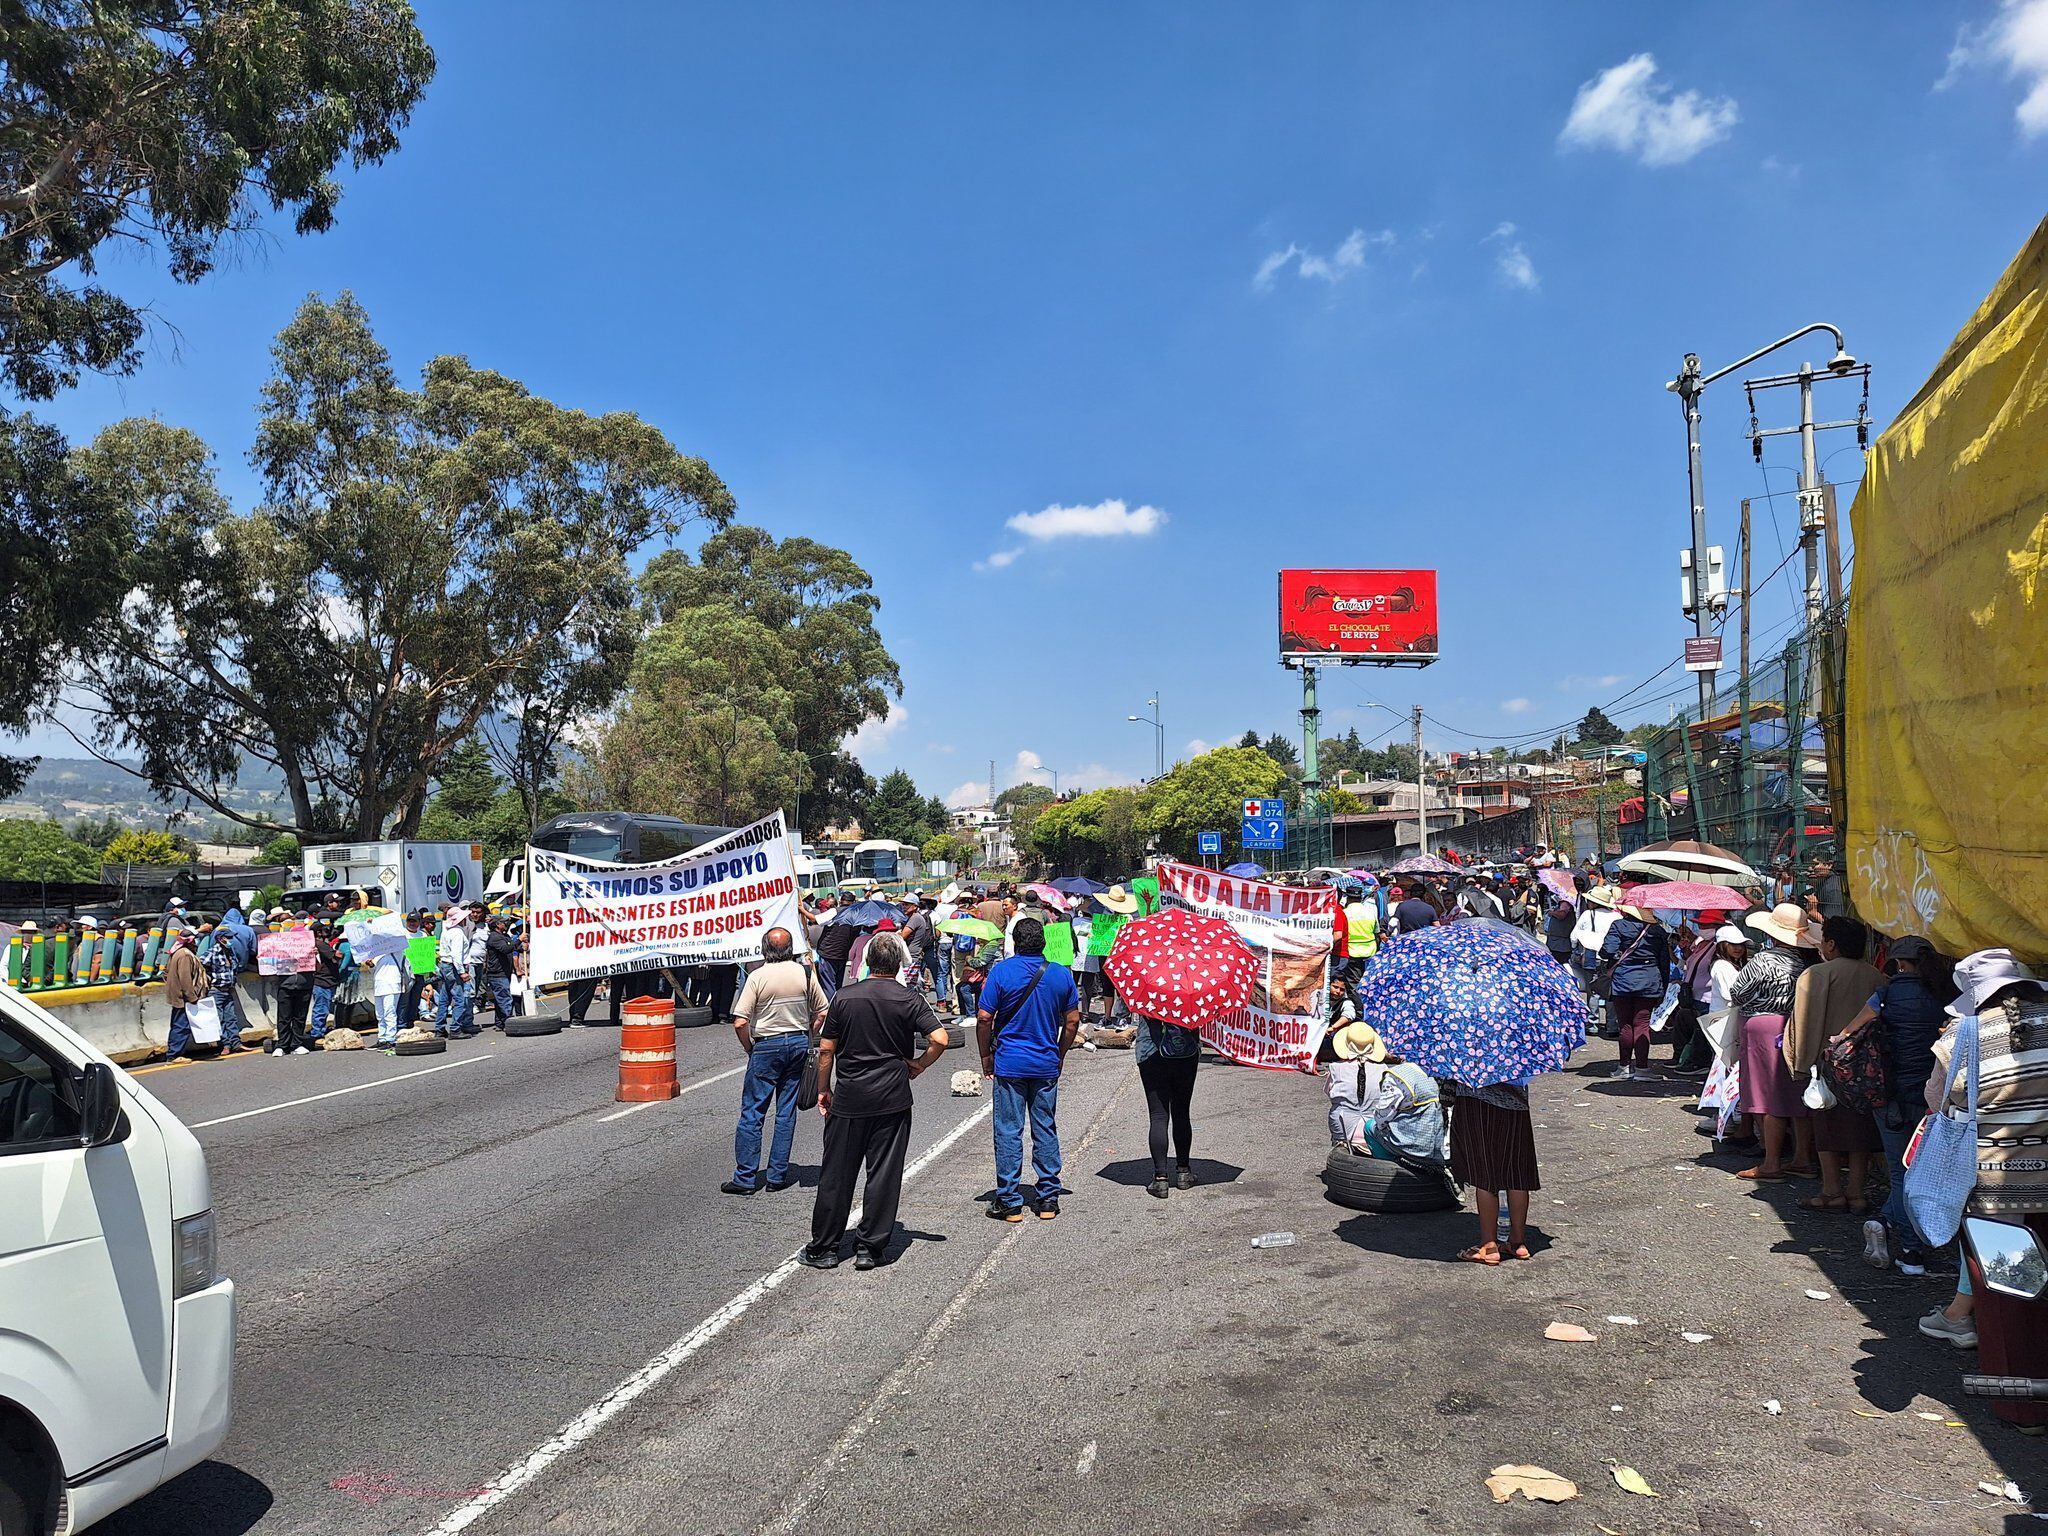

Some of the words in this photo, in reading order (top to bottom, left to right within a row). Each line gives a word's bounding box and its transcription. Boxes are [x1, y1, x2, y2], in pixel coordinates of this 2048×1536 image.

[1265, 809, 1281, 817] 074
[535, 854, 560, 873] SR.
[558, 874, 663, 899] PEDIMOS
[669, 867, 698, 891] SU
[703, 851, 768, 885] APOYO
[427, 871, 443, 887] red
[1159, 867, 1211, 903] ALTO
[1217, 878, 1233, 906] A
[1240, 883, 1271, 912] LA
[1279, 889, 1336, 914] TALA
[535, 909, 563, 928] LOS
[567, 902, 665, 925] TALAMONTES
[669, 893, 715, 916] ESTÁN
[719, 875, 794, 909] ACABANDO
[575, 930, 606, 950] CON
[609, 922, 689, 946] NUESTROS
[693, 909, 763, 936] BOSQUES
[1228, 910, 1249, 923] San
[554, 965, 608, 981] COMUNIDAD
[610, 961, 629, 974] SAN
[630, 955, 665, 971] MIGUEL
[1253, 1013, 1266, 1037] se
[1269, 1018, 1309, 1045] acaba
[1225, 1031, 1256, 1059] agua
